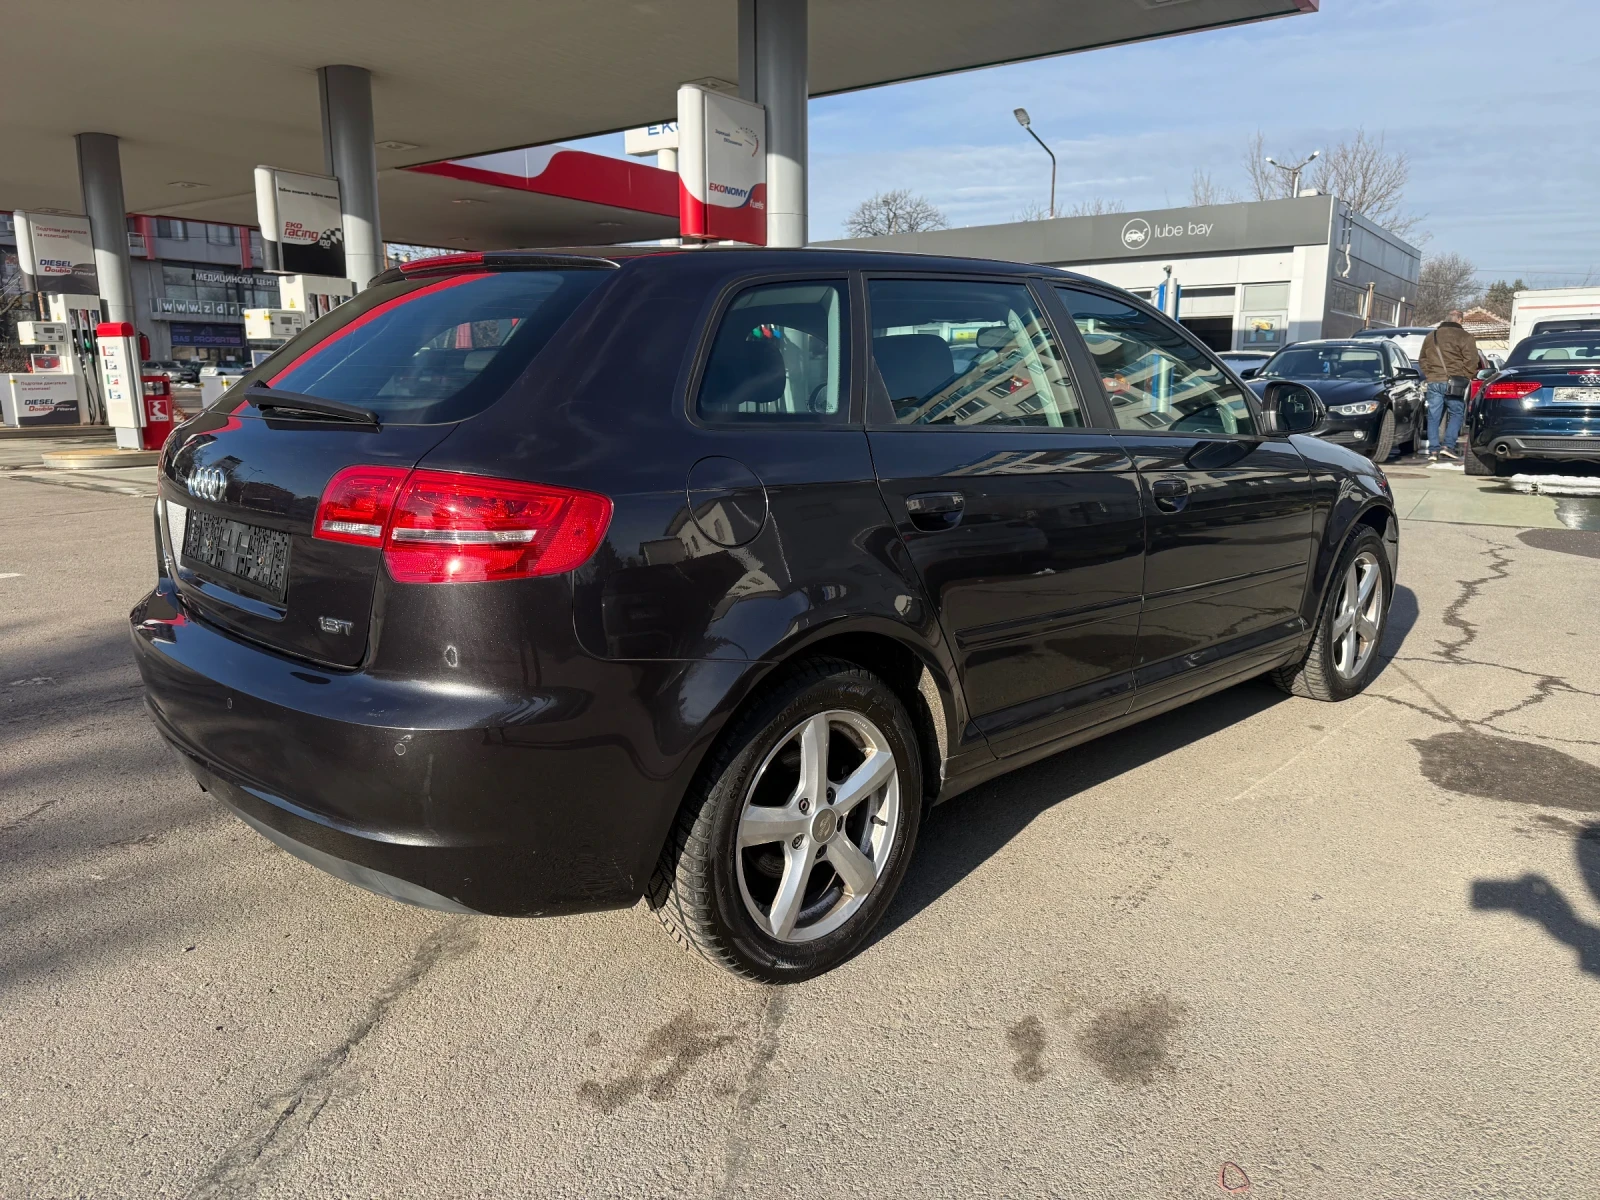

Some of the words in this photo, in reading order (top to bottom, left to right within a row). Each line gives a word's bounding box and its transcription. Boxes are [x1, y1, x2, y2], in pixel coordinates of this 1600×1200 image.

[648, 122, 678, 136] EK
[709, 182, 748, 198] EKONOMY
[750, 199, 764, 210] fuels
[285, 221, 303, 229] EKO
[1154, 224, 1183, 238] lube
[1188, 221, 1214, 237] bay
[284, 228, 319, 241] racing
[319, 239, 331, 247] 100
[40, 259, 73, 267] DIESEL
[44, 266, 71, 274] Double
[195, 273, 254, 285] МЕДИЦИНСКИ
[172, 335, 190, 343] BAS
